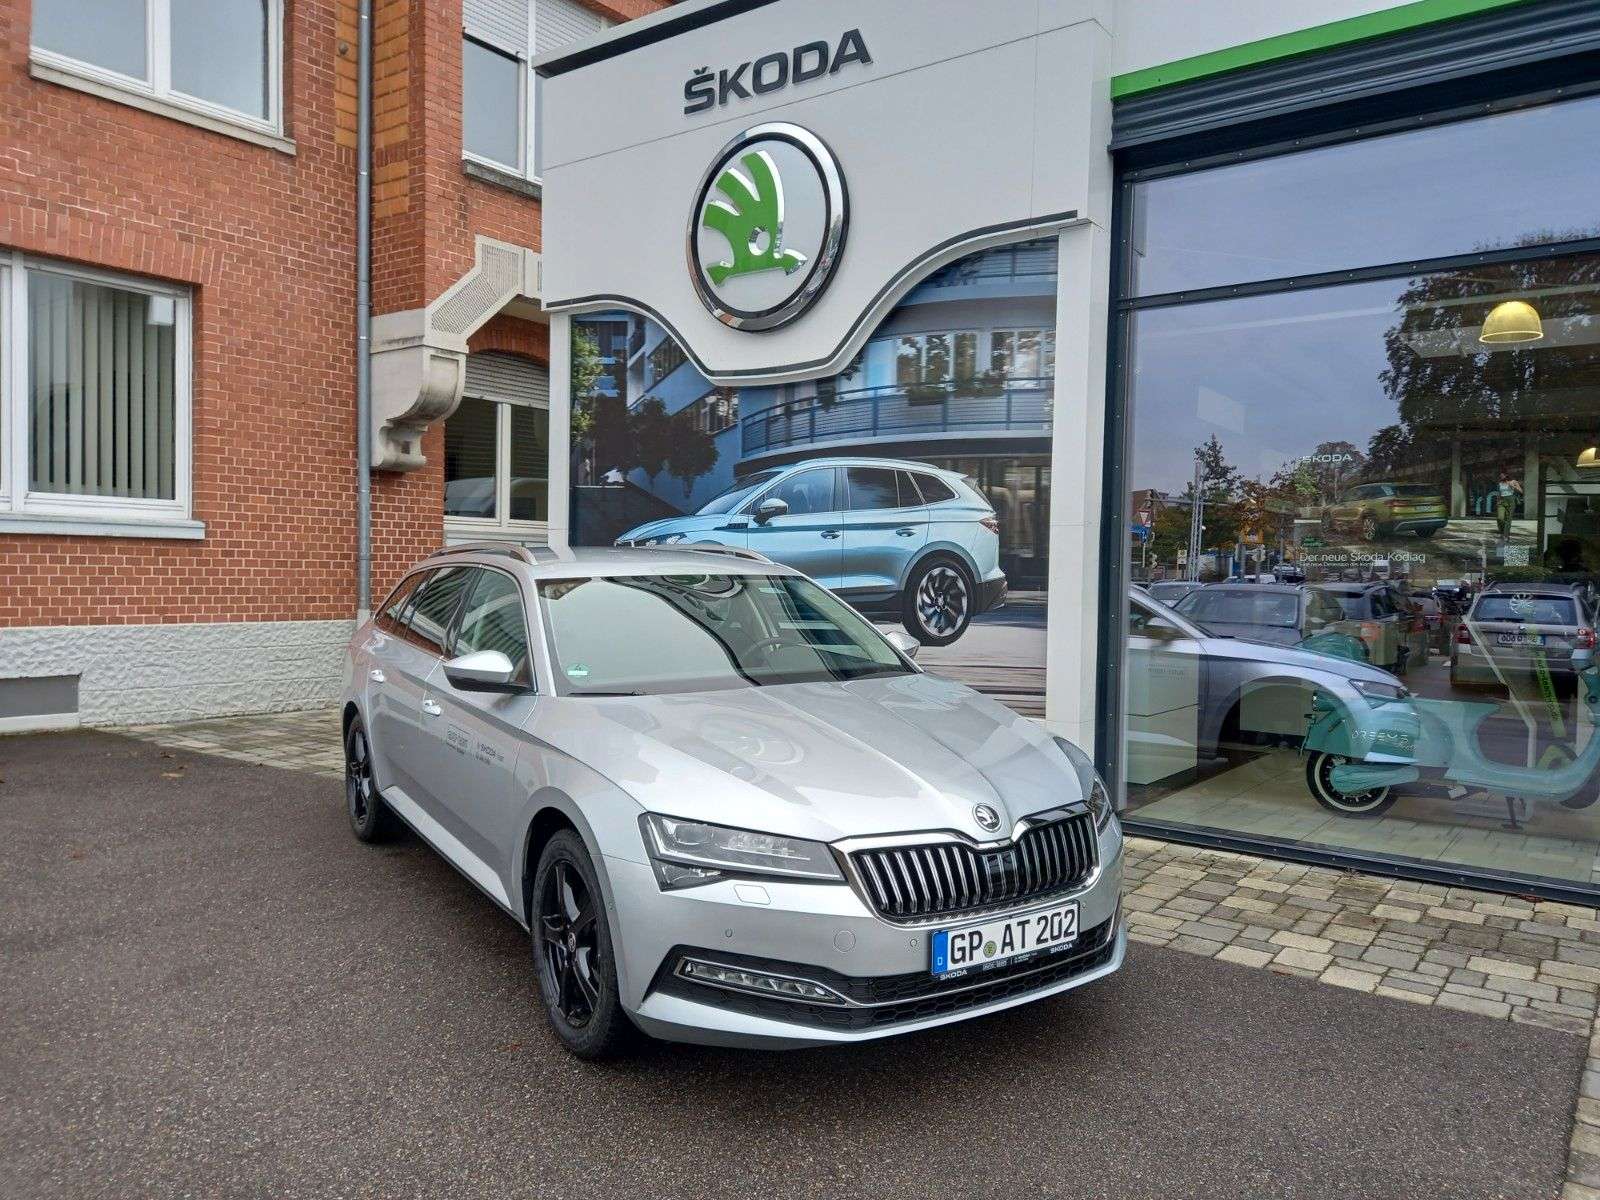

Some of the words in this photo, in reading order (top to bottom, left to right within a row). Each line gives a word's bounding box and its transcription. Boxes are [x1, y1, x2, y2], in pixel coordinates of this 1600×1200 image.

[684, 28, 874, 115] ŠKODA
[1300, 553, 1320, 562] Der
[1322, 554, 1347, 562] neue
[1387, 551, 1426, 564] Kodiaq
[950, 930, 983, 965] GP
[1001, 918, 1031, 954] AT
[1035, 908, 1076, 945] 202
